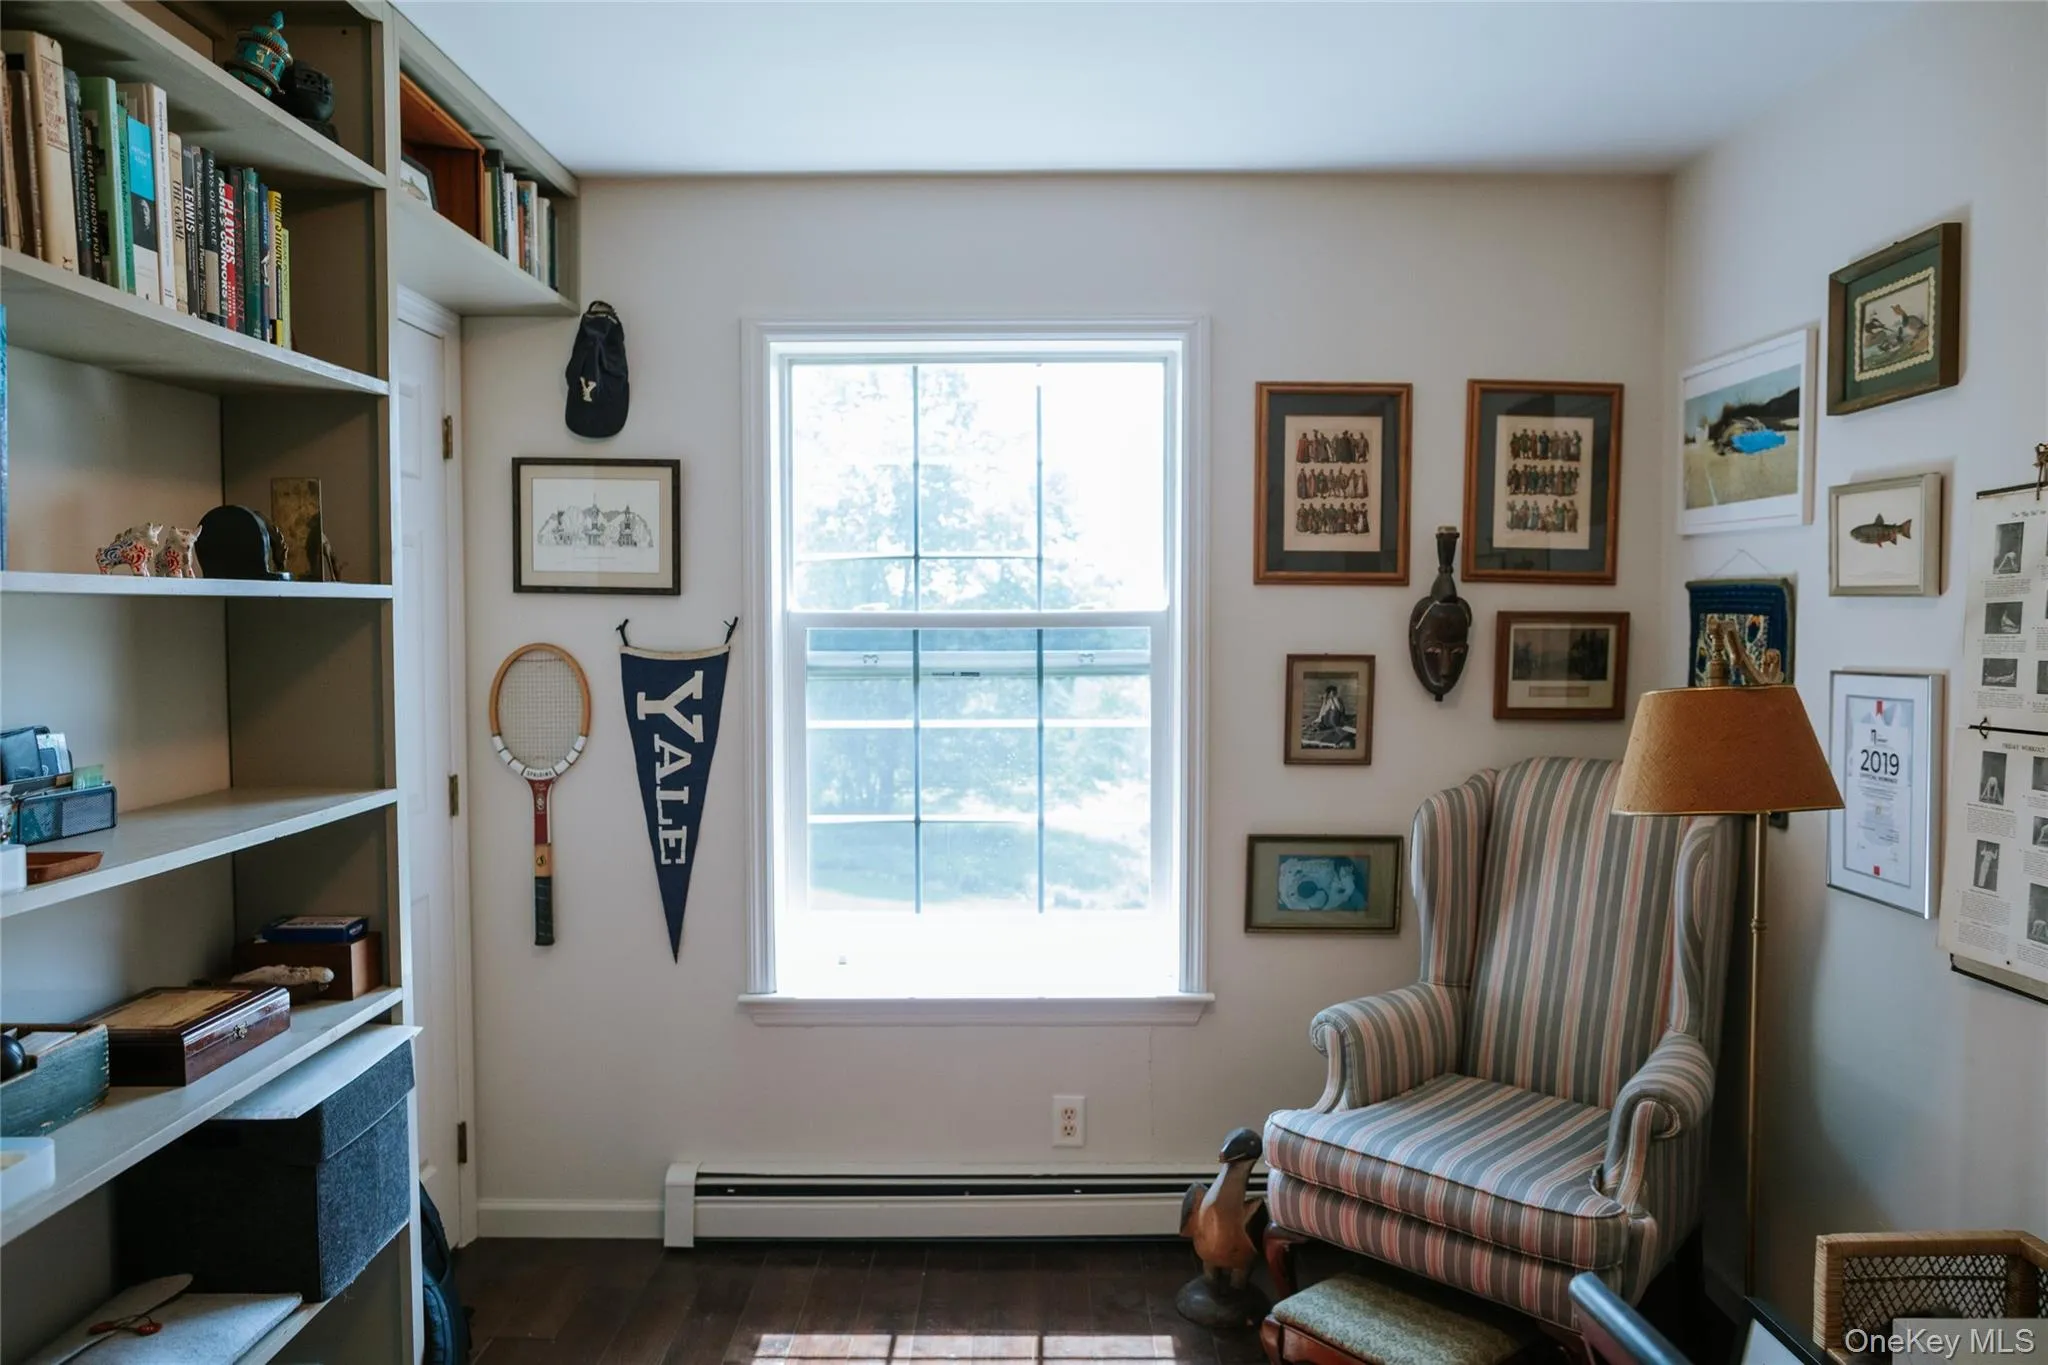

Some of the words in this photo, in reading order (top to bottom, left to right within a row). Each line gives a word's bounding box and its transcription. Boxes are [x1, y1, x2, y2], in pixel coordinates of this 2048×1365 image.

[87, 149, 95, 183] GREAT
[89, 186, 98, 234] LONDON
[172, 180, 182, 203] THE
[184, 186, 195, 233] TENNIS
[209, 190, 216, 204] OF
[174, 205, 184, 242] GAME
[224, 199, 235, 264] PLAYERS
[233, 208, 244, 269] LAMAR
[92, 236, 101, 264] PUBS
[220, 229, 228, 299] CONNORS
[236, 274, 245, 323] HUNT
[580, 376, 597, 402] Y
[525, 769, 553, 777] SPALDING
[637, 671, 704, 865] YALE
[1860, 749, 1899, 776] 2019
